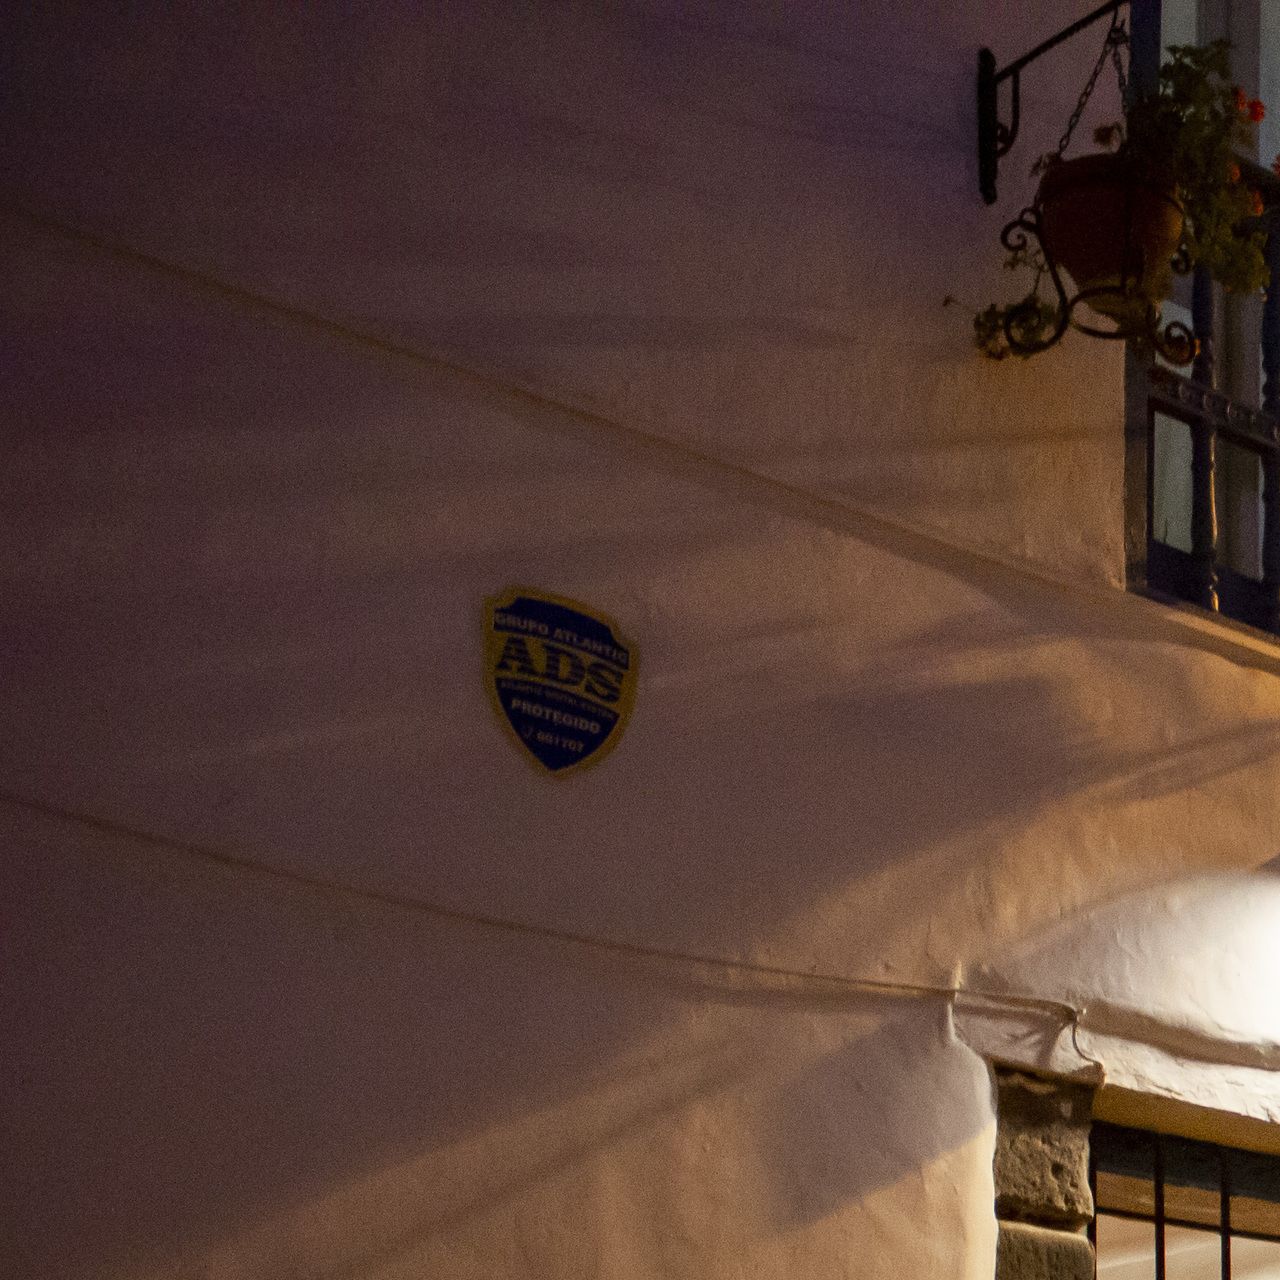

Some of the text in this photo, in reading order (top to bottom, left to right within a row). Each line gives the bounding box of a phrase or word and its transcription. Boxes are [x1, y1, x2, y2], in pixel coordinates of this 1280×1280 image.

[494, 612, 627, 663] GRUPO ATLANTIC
[497, 636, 623, 703] ADS
[511, 698, 600, 733] PROTEGIDO
